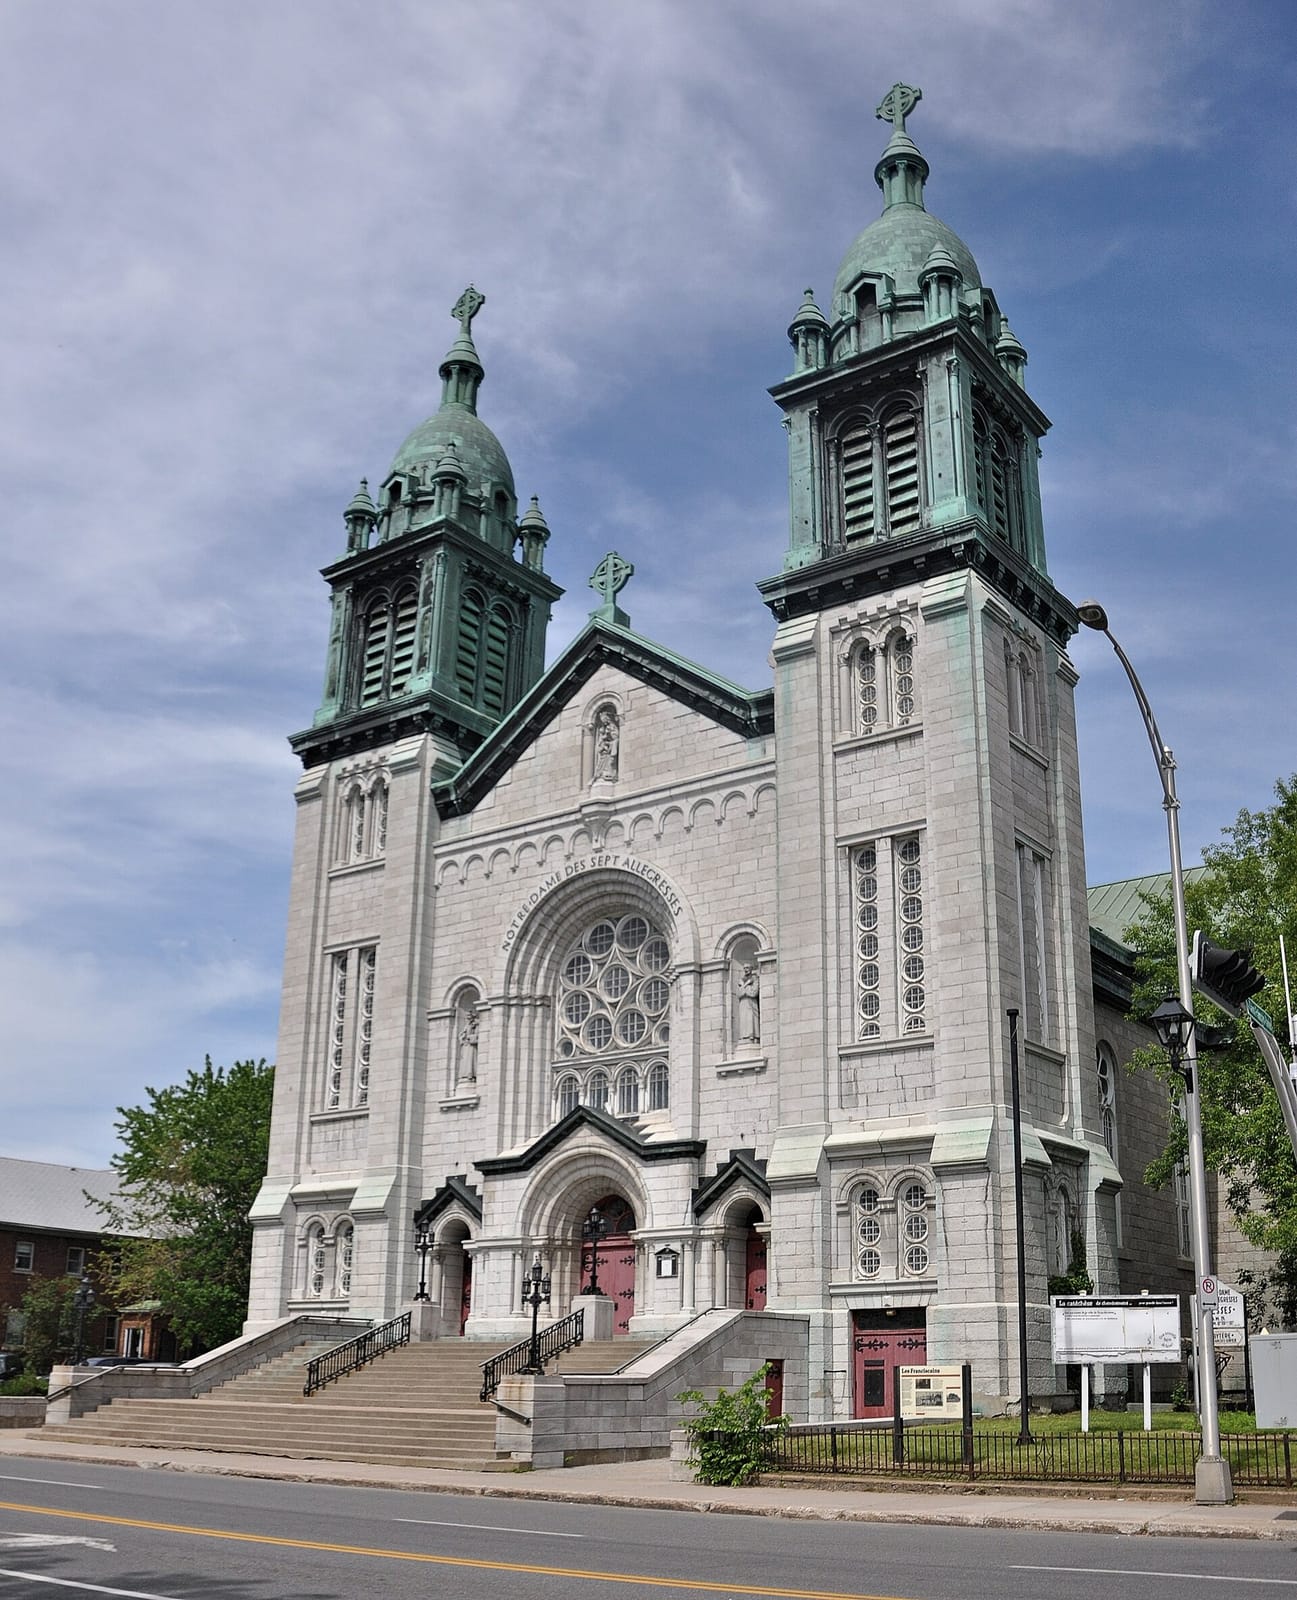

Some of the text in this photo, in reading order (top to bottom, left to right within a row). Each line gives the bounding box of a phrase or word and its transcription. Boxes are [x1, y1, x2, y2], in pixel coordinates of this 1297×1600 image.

[564, 859, 586, 877] DES
[590, 855, 620, 868] SEPT
[622, 857, 683, 917] ALLEGRESSES
